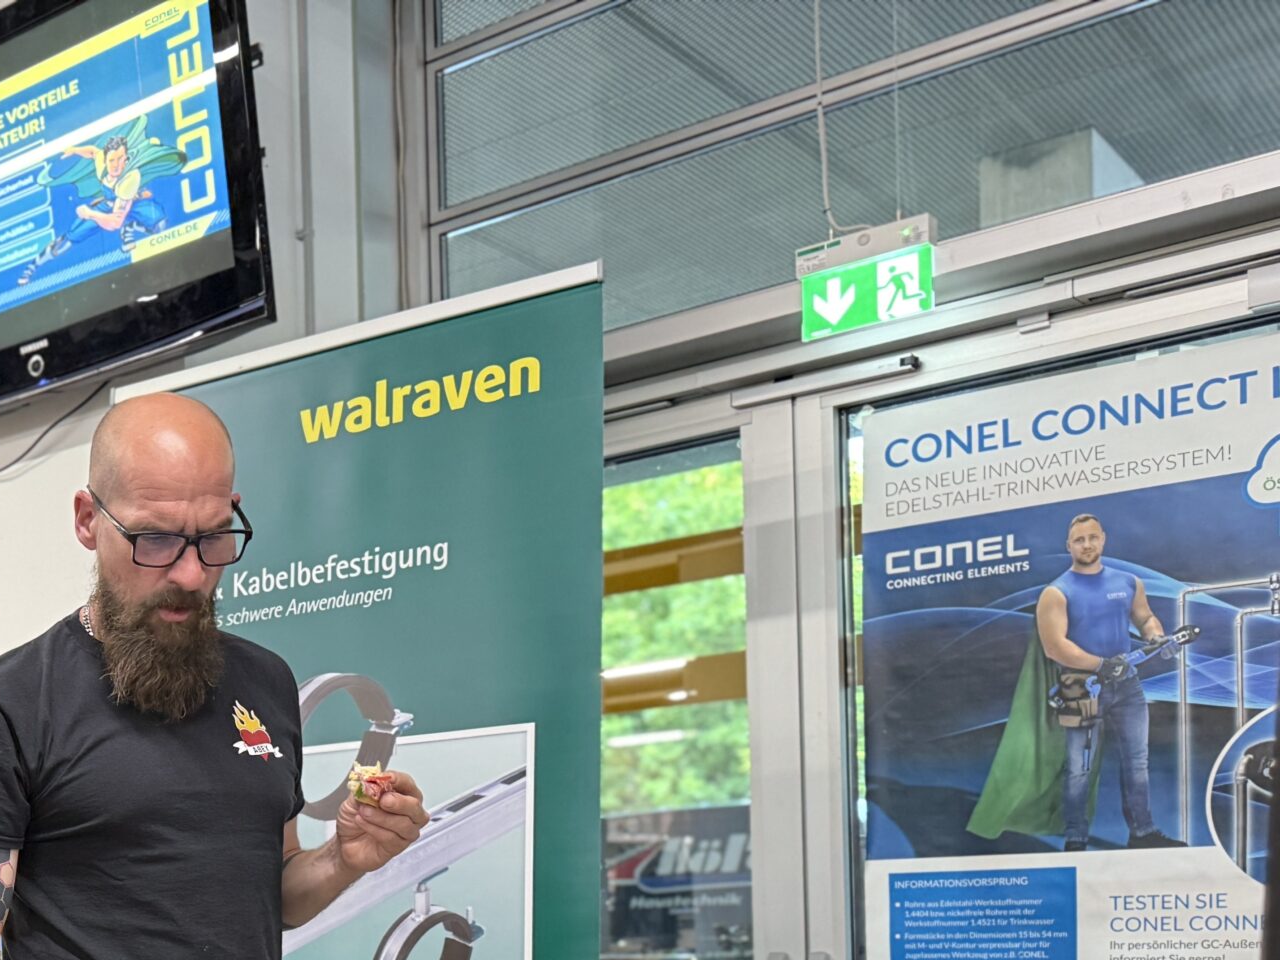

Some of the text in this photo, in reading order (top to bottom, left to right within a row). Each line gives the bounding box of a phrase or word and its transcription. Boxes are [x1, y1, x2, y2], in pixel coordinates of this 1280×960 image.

[5, 79, 80, 122] VORTEILE
[149, 222, 198, 247] CONEL.DE
[299, 356, 541, 444] walraven
[884, 370, 1259, 468] CONEL CONNECT
[885, 444, 1106, 498] DAS NEUE INNOVATIVE
[885, 444, 1232, 518] EDELSTAHL-TRINKWASSERSYSTEM!
[885, 534, 1030, 576] CONEL
[233, 541, 449, 599] Kabelbefestigung
[886, 561, 1030, 590] CONNECTING ELEMENTS
[226, 604, 282, 627] schwere
[286, 585, 392, 617] Anwendungen
[894, 876, 1029, 889] INFORMATIONSVORSPRUNG
[1022, 907, 1035, 915] der
[1109, 892, 1228, 911] TESTEN SIE
[969, 930, 1017, 939] Dimensionen
[1029, 929, 1040, 938] bis
[1041, 930, 1052, 938] 54
[1053, 930, 1068, 938] mm
[971, 918, 996, 926] 1.4521
[997, 918, 1008, 926] für
[1010, 918, 1054, 926] Trinkwasser
[1110, 916, 1184, 932] CONEL
[929, 941, 943, 949] und
[1039, 940, 1050, 948] für
[1109, 940, 1125, 950] Ihr
[1128, 940, 1198, 952] persönlicher
